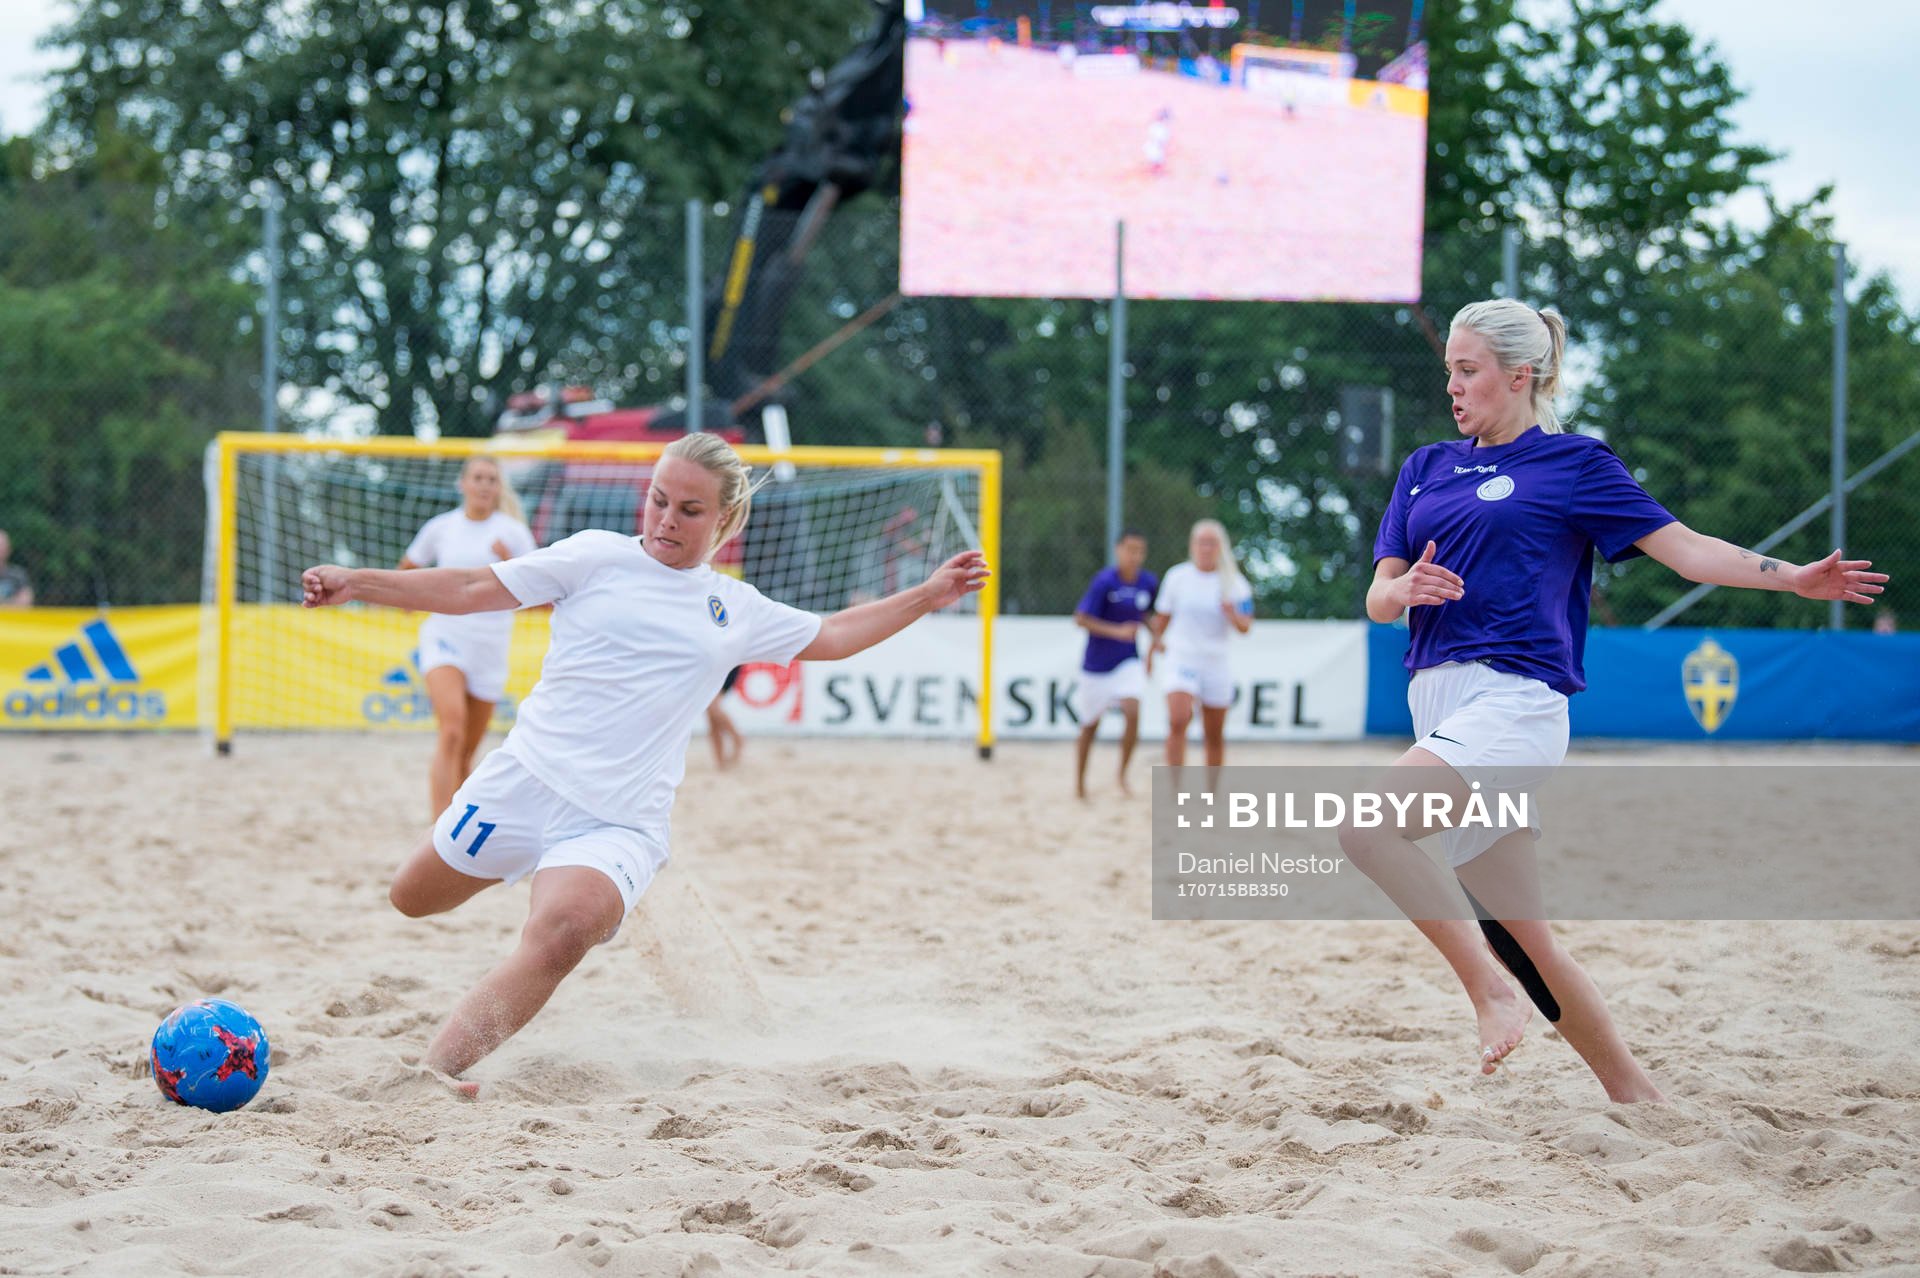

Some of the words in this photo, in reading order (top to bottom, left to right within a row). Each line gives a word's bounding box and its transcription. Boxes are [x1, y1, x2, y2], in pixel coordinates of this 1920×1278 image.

[4, 686, 168, 723] adidas
[823, 674, 1125, 726] SVENSK
[450, 803, 497, 858] 11
